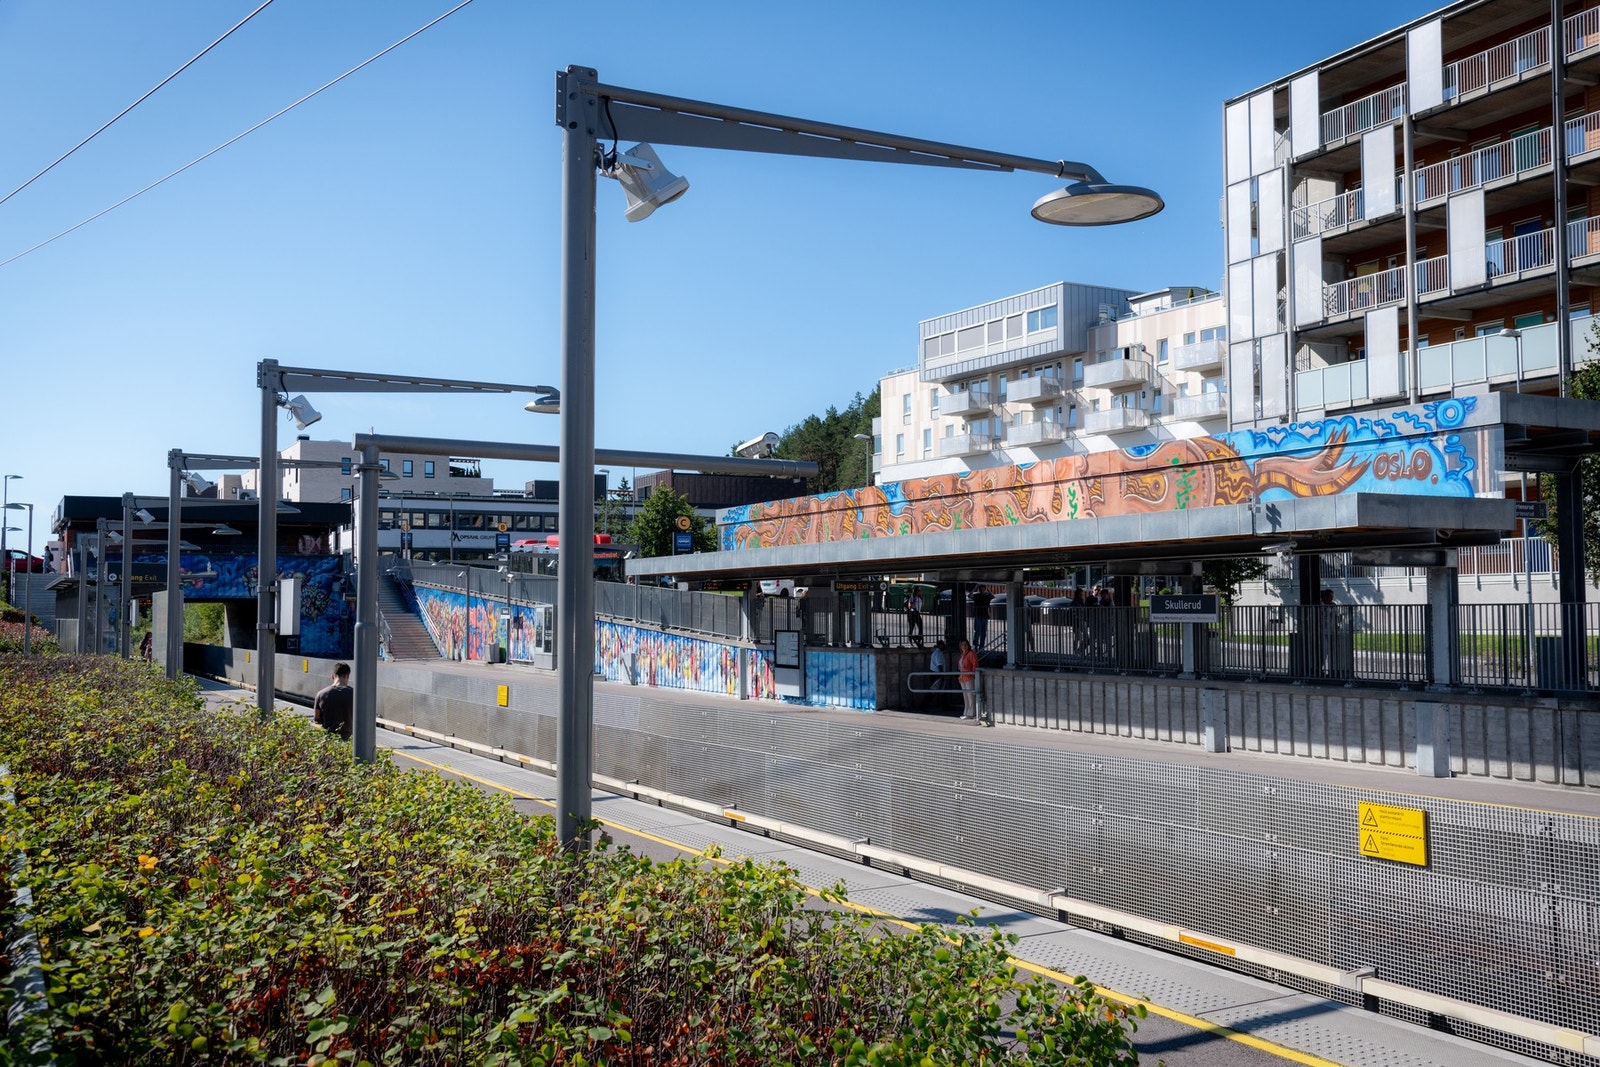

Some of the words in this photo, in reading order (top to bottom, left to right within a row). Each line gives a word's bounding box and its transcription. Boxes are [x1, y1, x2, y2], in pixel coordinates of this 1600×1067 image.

[680, 518, 688, 527] C
[119, 574, 143, 582] Uang
[836, 582, 857, 590] Utgang
[1164, 599, 1202, 610] Skullerud
